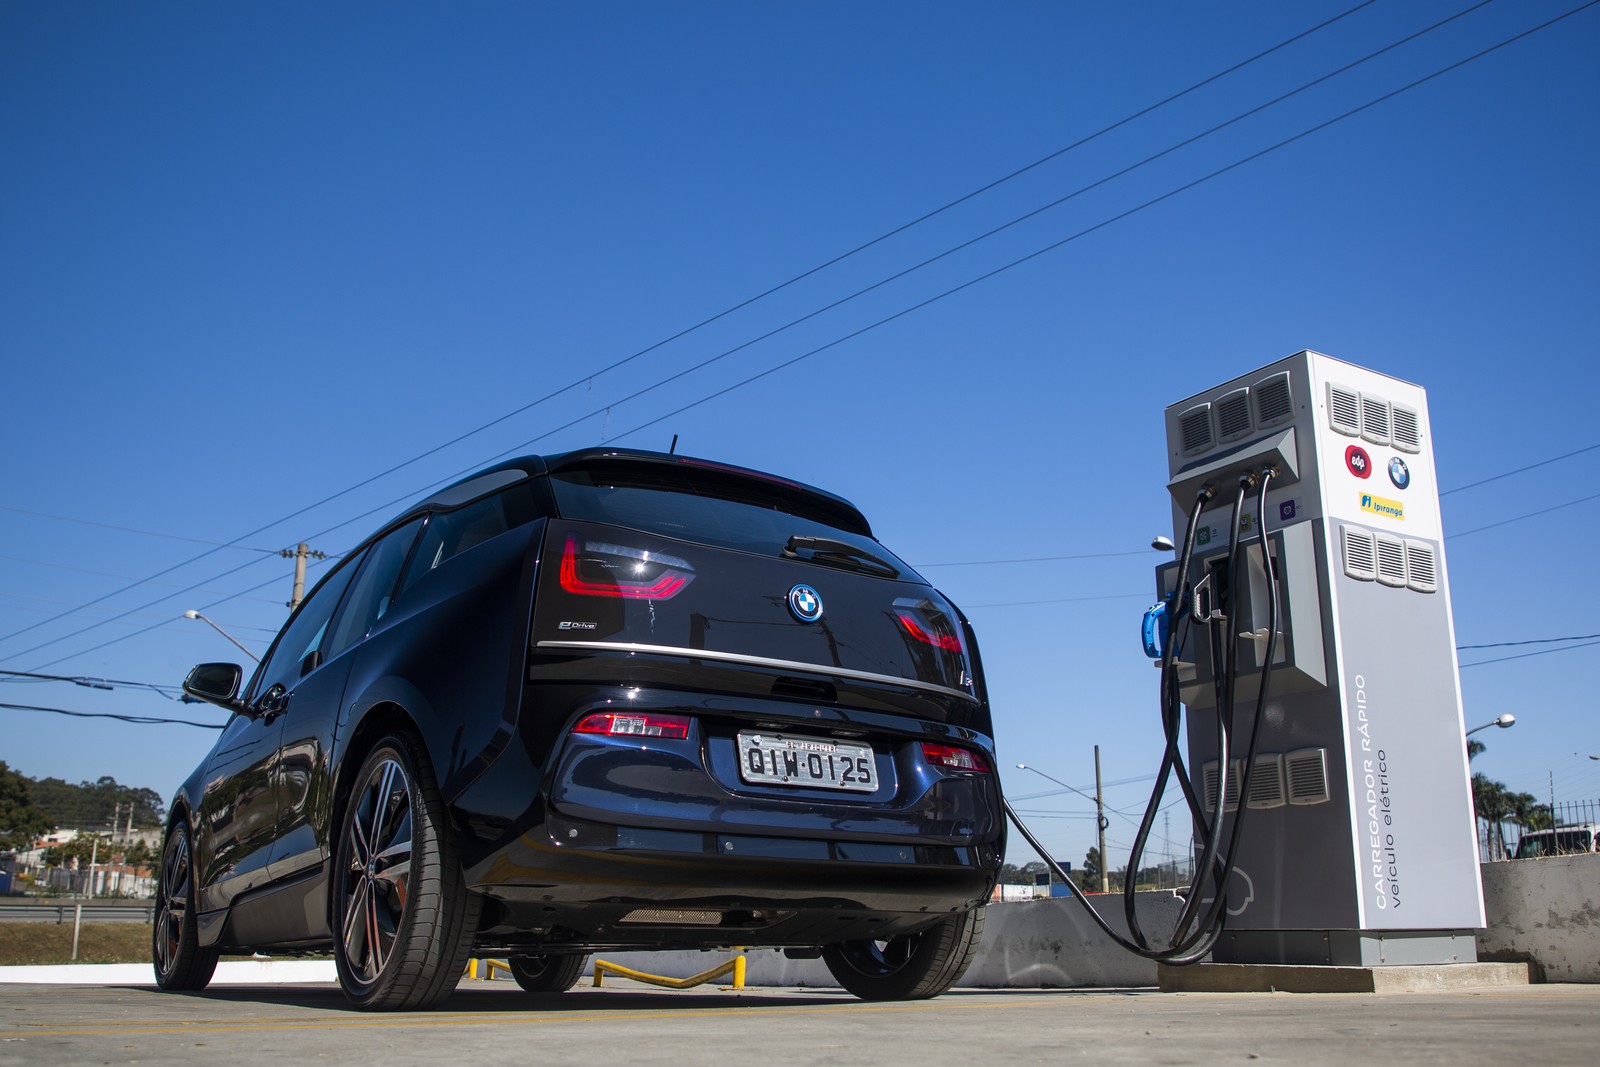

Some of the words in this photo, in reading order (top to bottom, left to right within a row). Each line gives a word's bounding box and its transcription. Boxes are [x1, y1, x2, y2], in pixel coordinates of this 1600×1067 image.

[1352, 455, 1365, 470] edp
[1374, 502, 1403, 517] Ipiranga
[1355, 674, 1372, 751] RÁPIDO
[1378, 750, 1392, 826] elétrico
[1364, 759, 1386, 909] CARREGADOR
[1384, 834, 1401, 909] veículo
